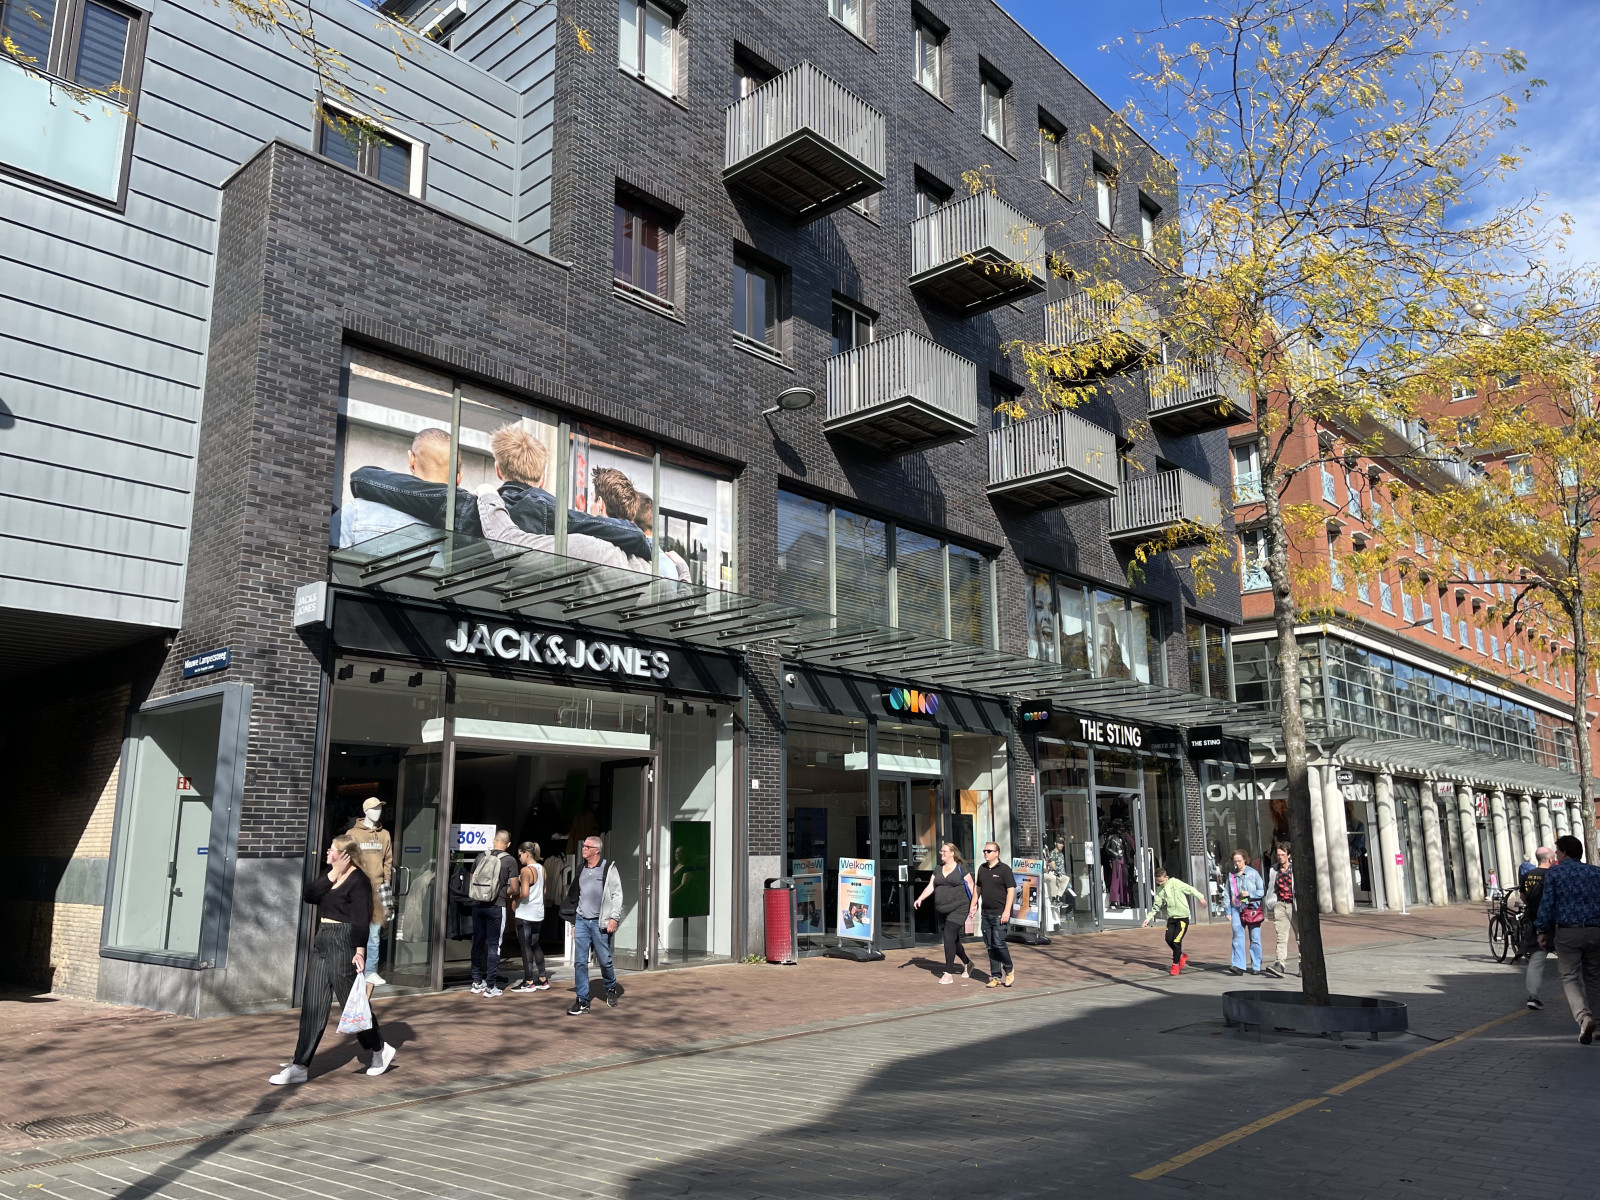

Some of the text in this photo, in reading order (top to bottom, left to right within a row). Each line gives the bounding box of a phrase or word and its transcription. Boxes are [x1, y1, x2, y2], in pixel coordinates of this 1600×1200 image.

[297, 602, 317, 616] JONES
[445, 621, 670, 680] JACK&JONES
[1079, 718, 1142, 748] THE STING
[1203, 738, 1221, 746] STING
[1206, 781, 1276, 802] ONLY
[456, 830, 487, 845] 30%
[840, 859, 873, 871] Welkom
[1014, 859, 1041, 870] Welkom
